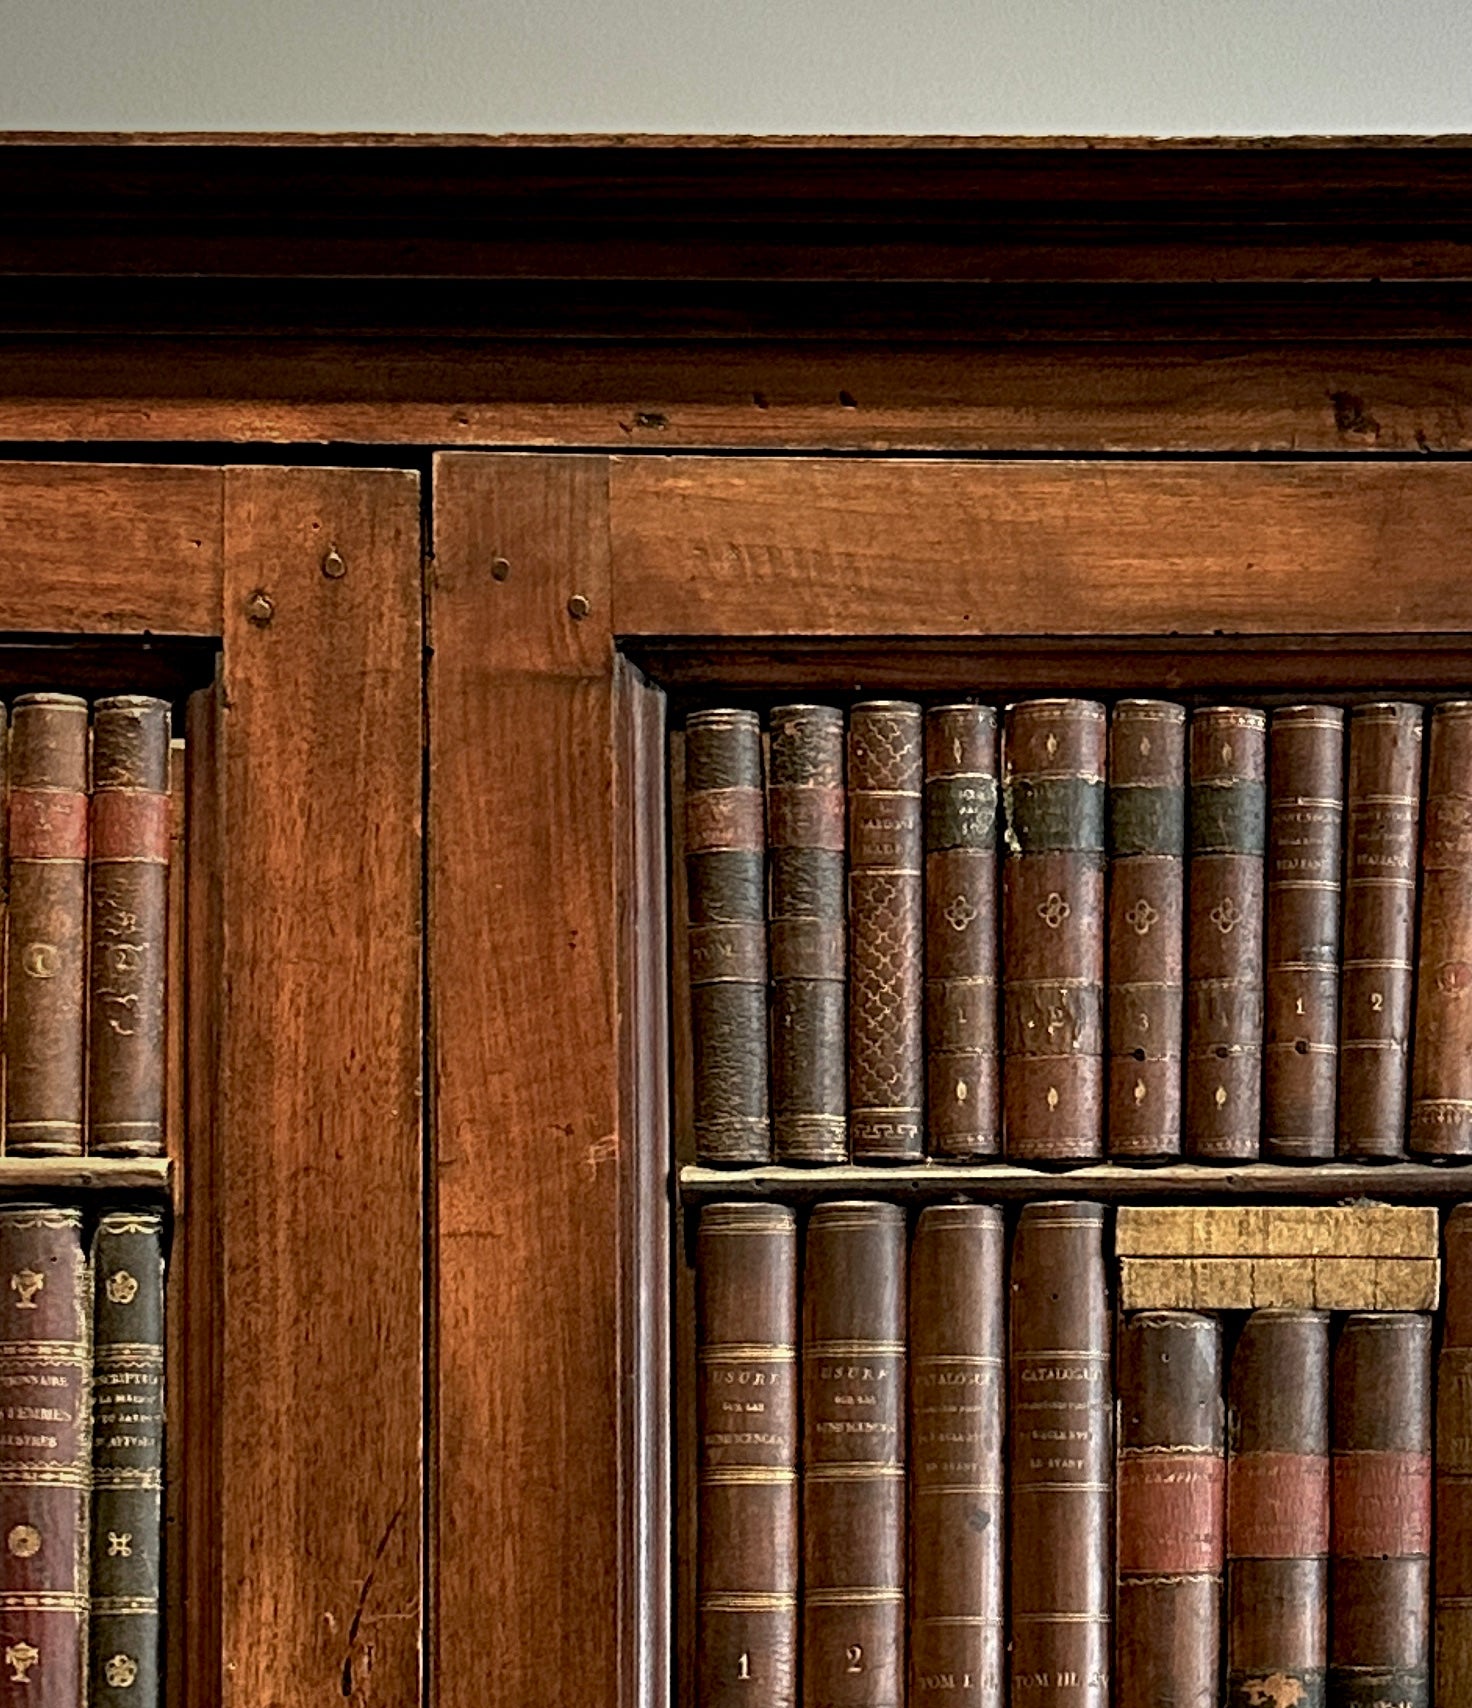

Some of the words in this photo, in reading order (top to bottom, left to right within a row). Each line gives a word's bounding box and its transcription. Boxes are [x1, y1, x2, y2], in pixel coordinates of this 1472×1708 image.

[1295, 997, 1306, 1015] 1
[1370, 993, 1383, 1011] 2
[737, 1652, 751, 1680] 1
[845, 1644, 863, 1673] 2
